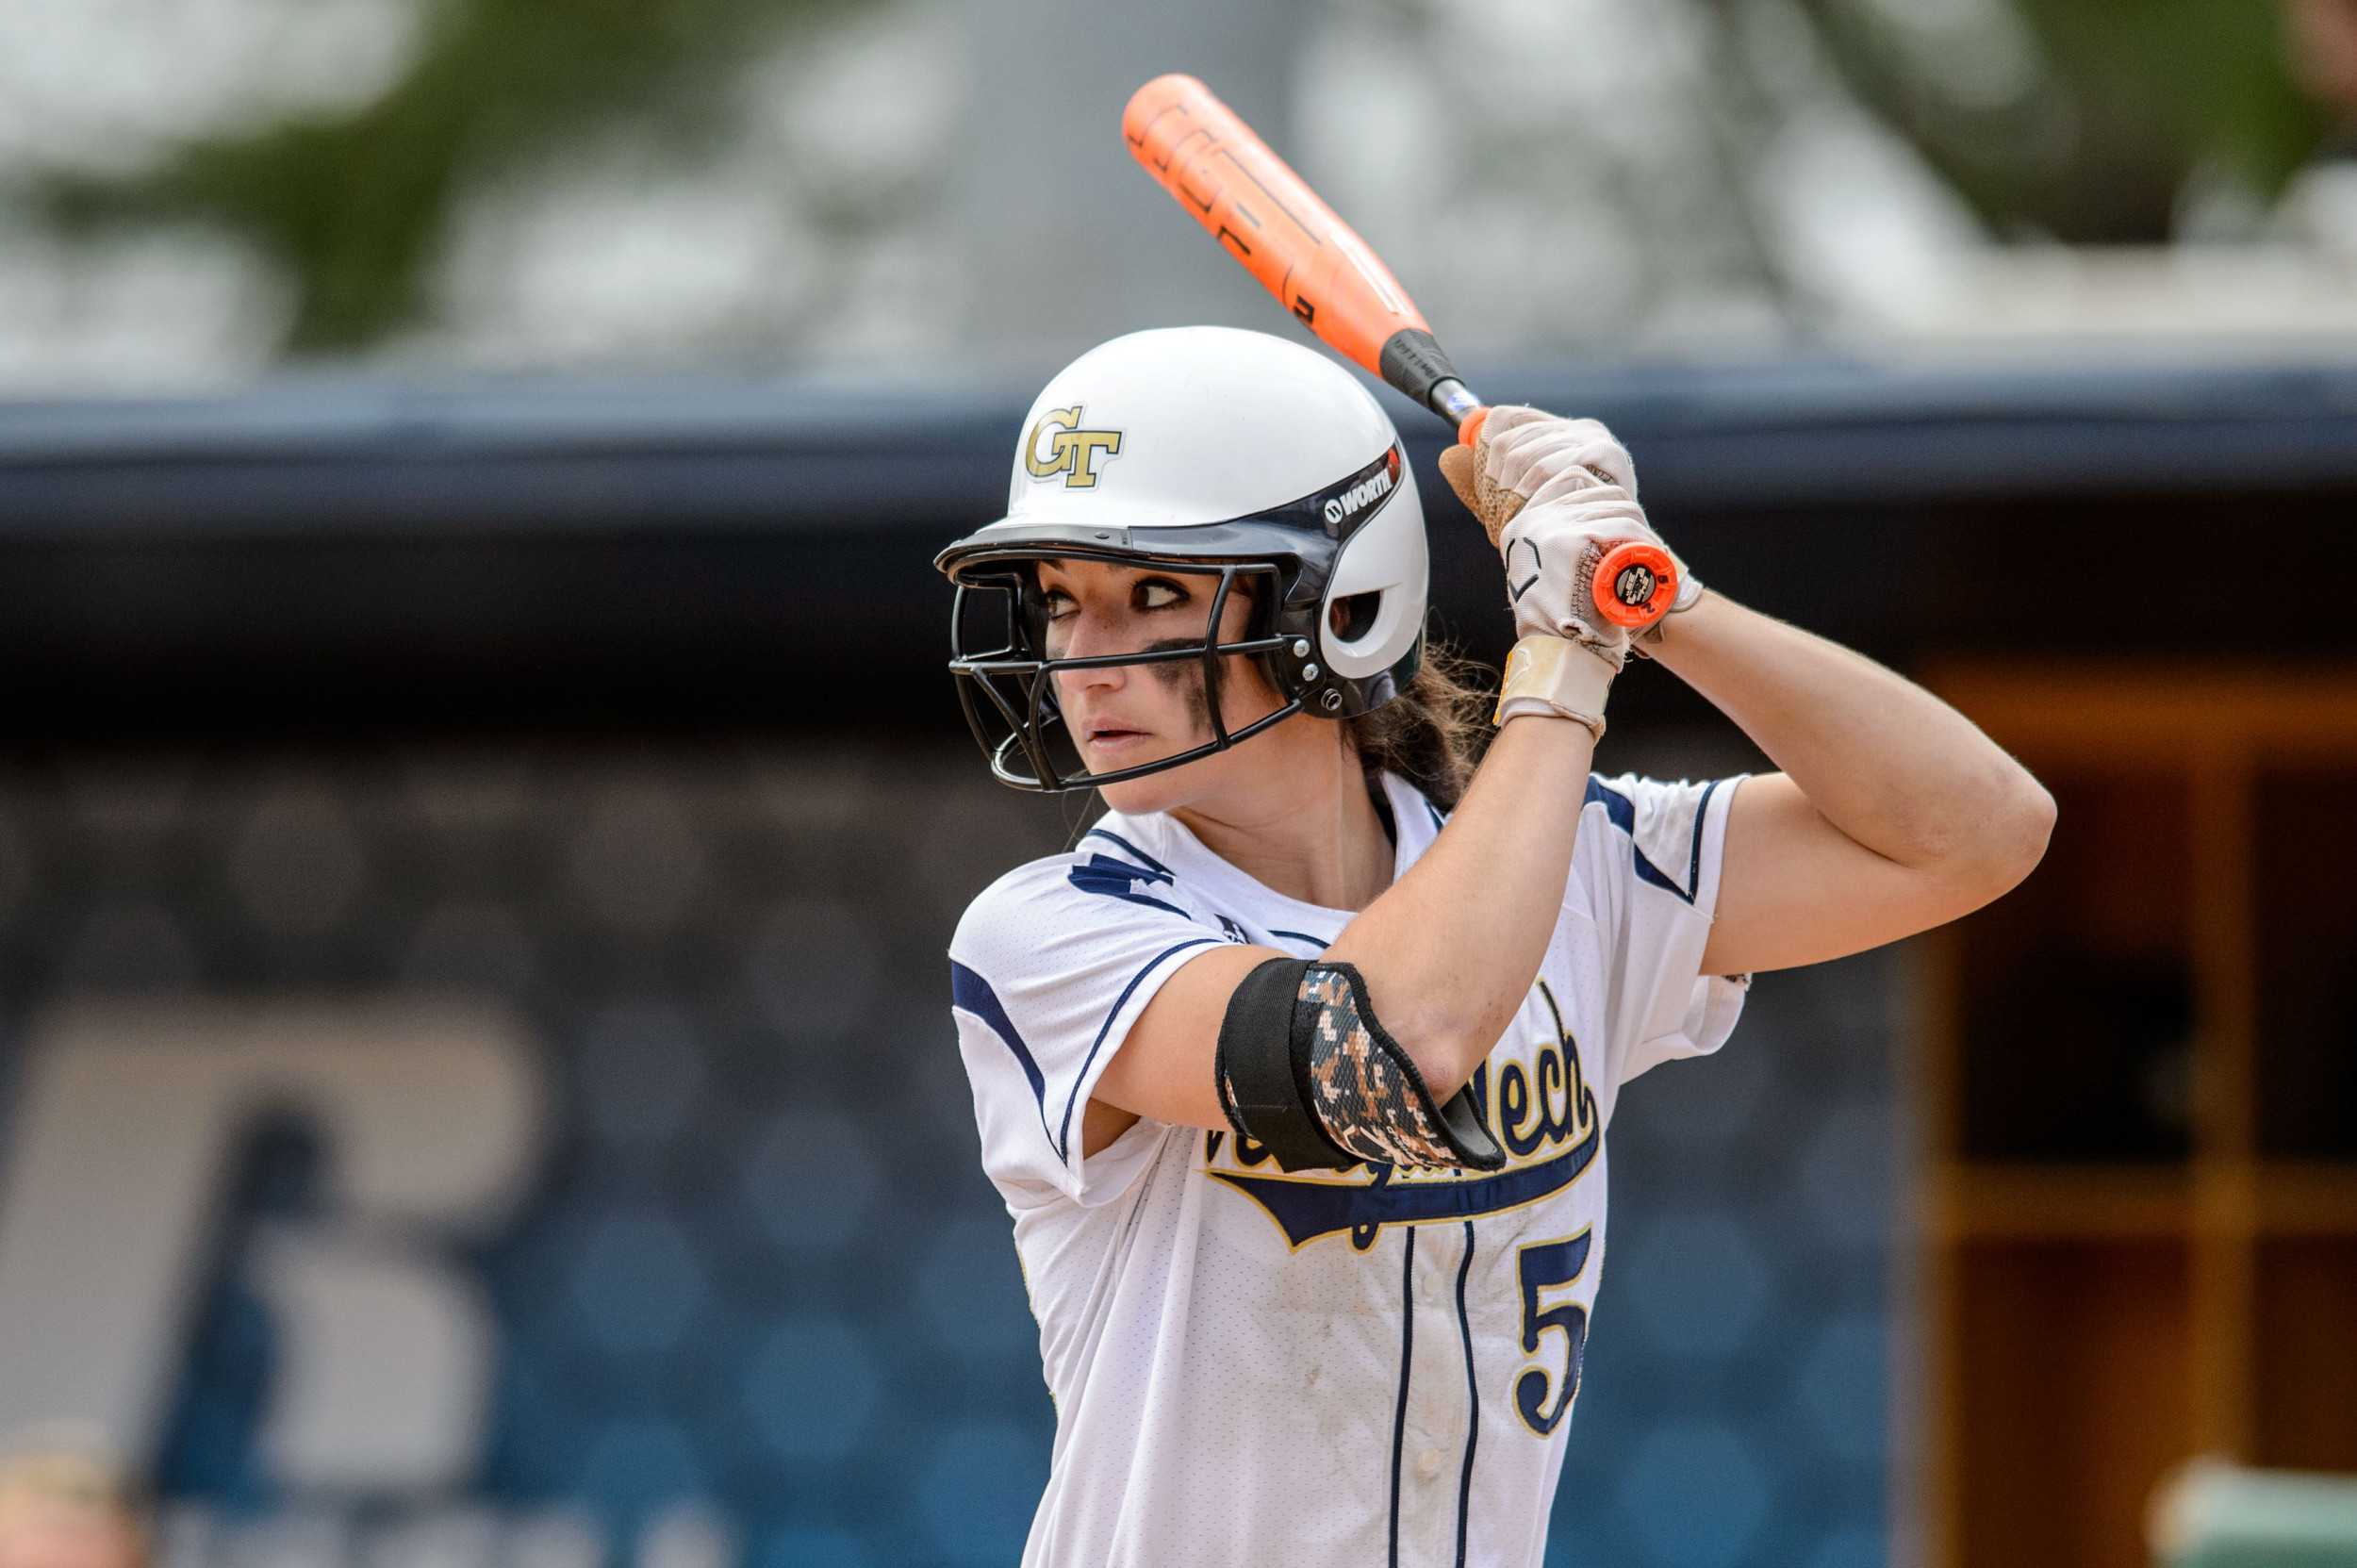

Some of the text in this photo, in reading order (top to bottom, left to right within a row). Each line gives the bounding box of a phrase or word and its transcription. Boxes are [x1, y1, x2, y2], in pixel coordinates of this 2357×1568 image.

[1025, 405, 1122, 488] GT
[1339, 467, 1393, 517] WORTH
[1511, 1223, 1593, 1440] 5
